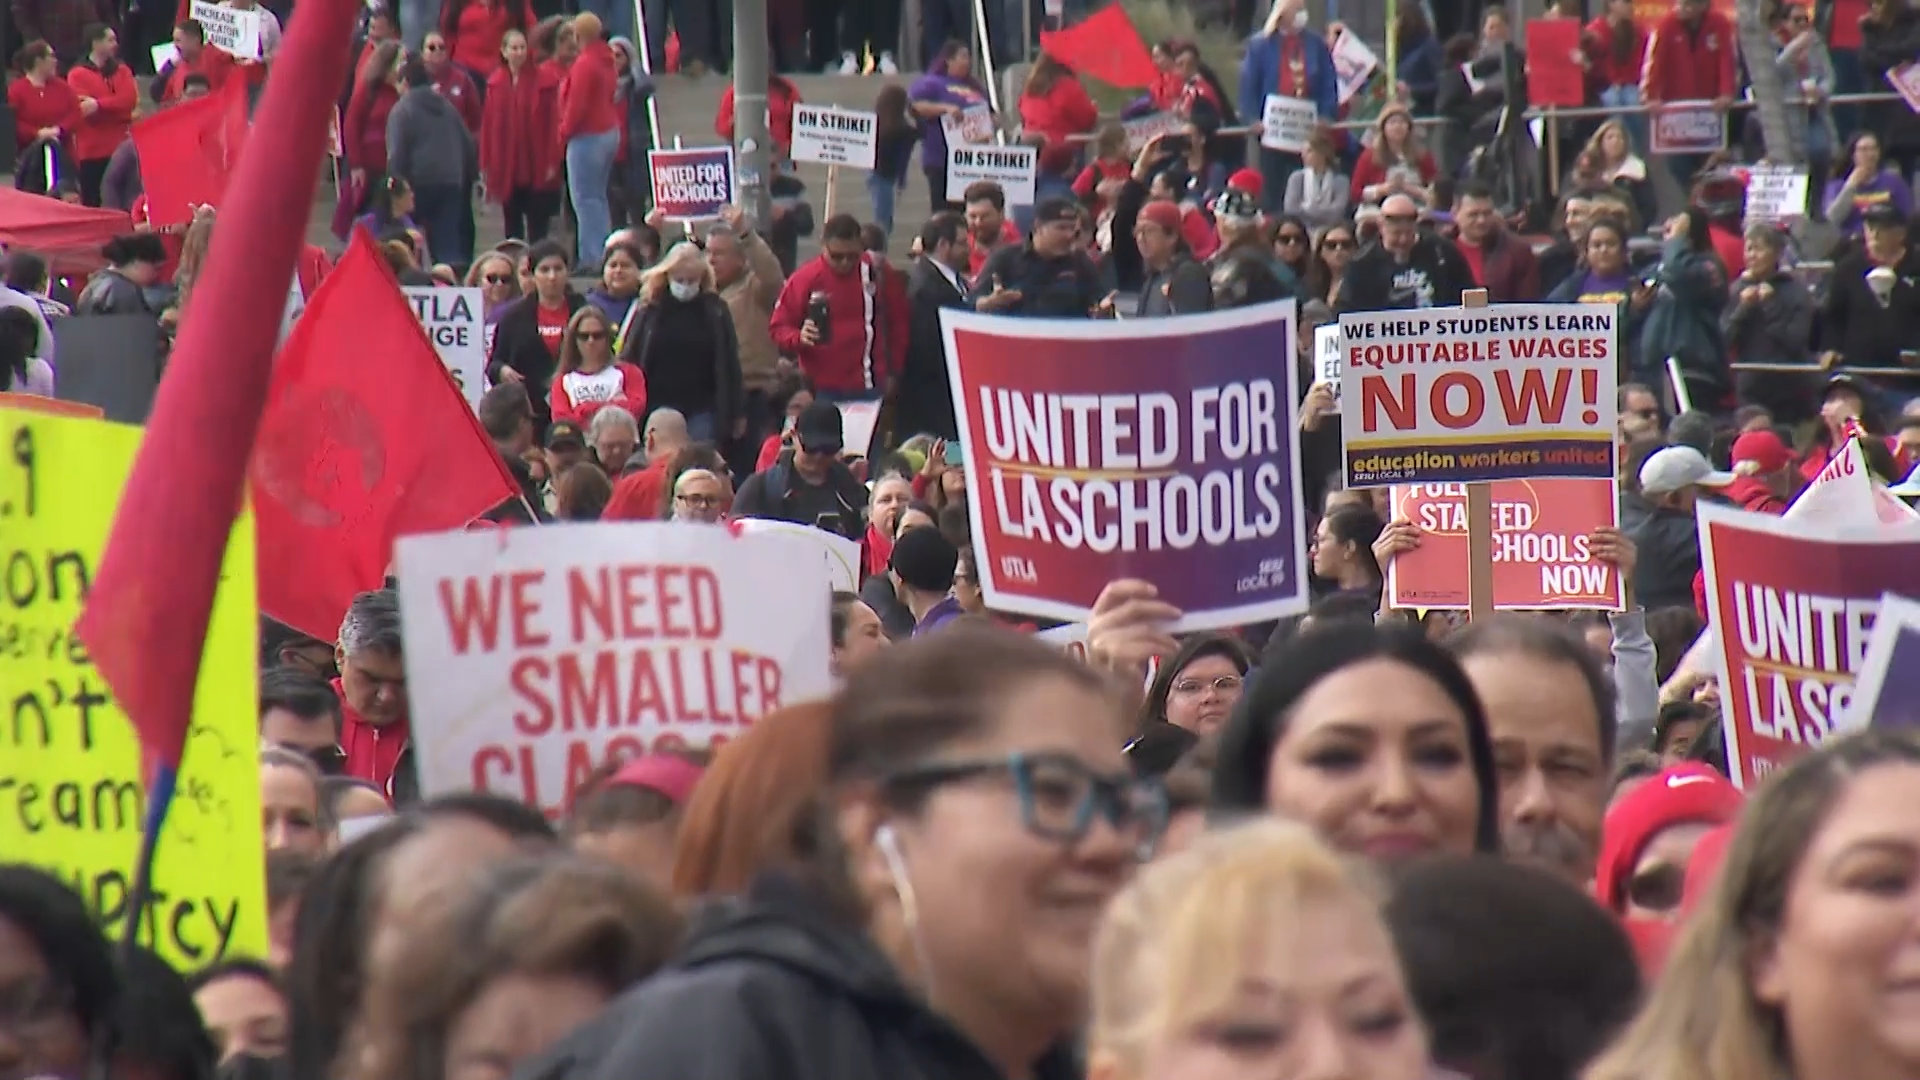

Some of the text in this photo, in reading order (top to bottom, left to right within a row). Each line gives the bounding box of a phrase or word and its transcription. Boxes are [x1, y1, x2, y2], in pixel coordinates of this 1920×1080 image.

[201, 20, 239, 38] DUCATOR
[799, 111, 871, 134] ON STRIKE!
[655, 163, 726, 184] UNITED FOR
[954, 149, 1030, 170] ON STRIKE!
[411, 294, 473, 323] TLA
[1345, 314, 1611, 340] WE HELP STUDENTS LEARN
[1350, 337, 1608, 369] EQUITABLE WAGES
[1361, 367, 1600, 433] NOW!
[979, 378, 1279, 469] UNITED FOR
[1353, 445, 1608, 473] education workers united
[1376, 470, 1402, 480] LOCAL
[1491, 532, 1591, 563] CHOOLS
[1001, 556, 1038, 583] UTLA
[1541, 565, 1609, 595] NOW
[438, 569, 550, 656] WE
[567, 563, 724, 643] NEED
[1733, 580, 1877, 673] UNITE
[510, 647, 783, 738] SMALLER
[12, 676, 106, 752] n't
[471, 732, 690, 820] CLA
